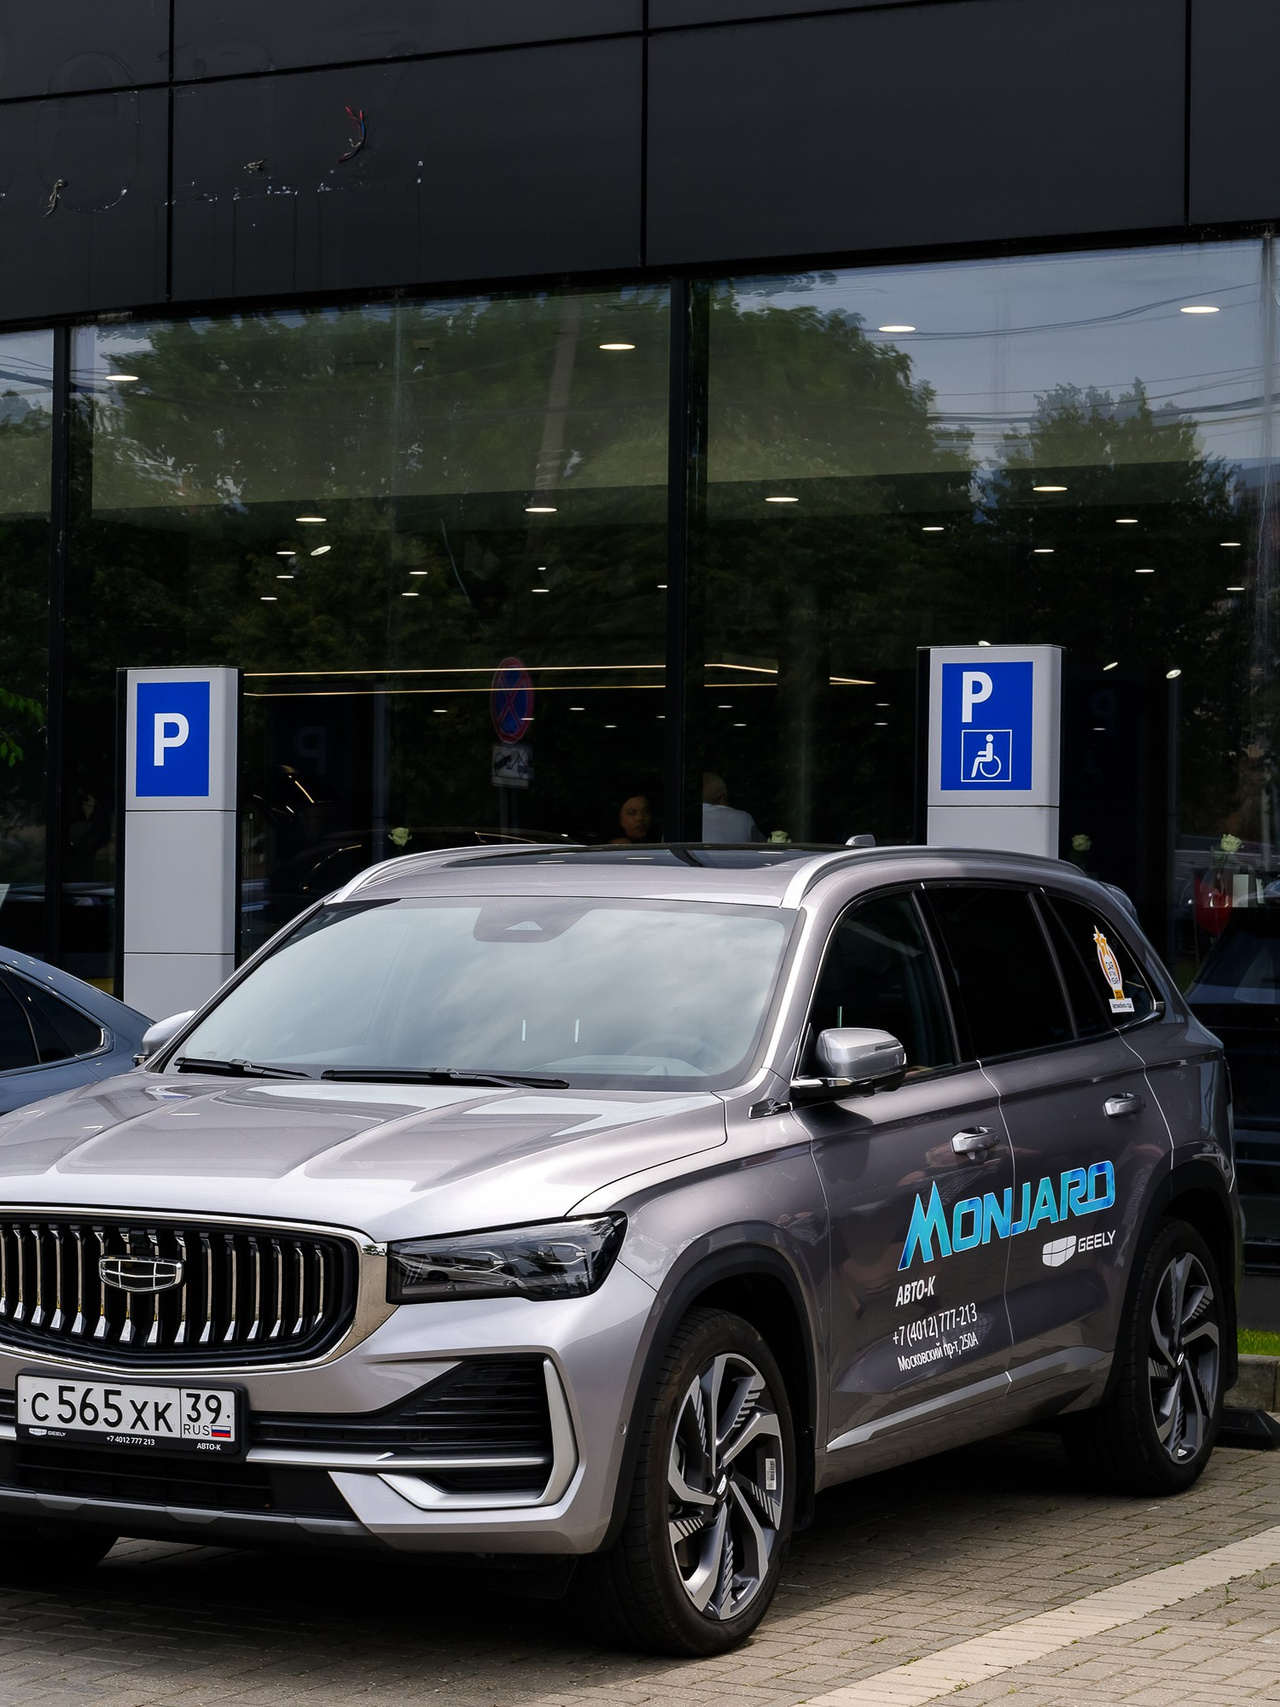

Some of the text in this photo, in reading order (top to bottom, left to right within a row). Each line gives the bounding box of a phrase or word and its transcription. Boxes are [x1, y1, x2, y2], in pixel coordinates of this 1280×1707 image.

[961, 671, 993, 723] P
[153, 712, 190, 767] P
[898, 1160, 1116, 1271] MONJARO
[1077, 1229, 1116, 1253] GEELY
[895, 1275, 936, 1308] АВТО-К
[892, 1302, 978, 1347] +7 (4012) 777-213
[897, 1331, 979, 1372] Московский пр-т, 250А
[31, 1385, 222, 1433] С565ХК 39
[106, 1435, 156, 1447] +7 4012 777 213
[183, 1423, 210, 1437] RUS
[196, 1442, 222, 1451] АВТО-К
